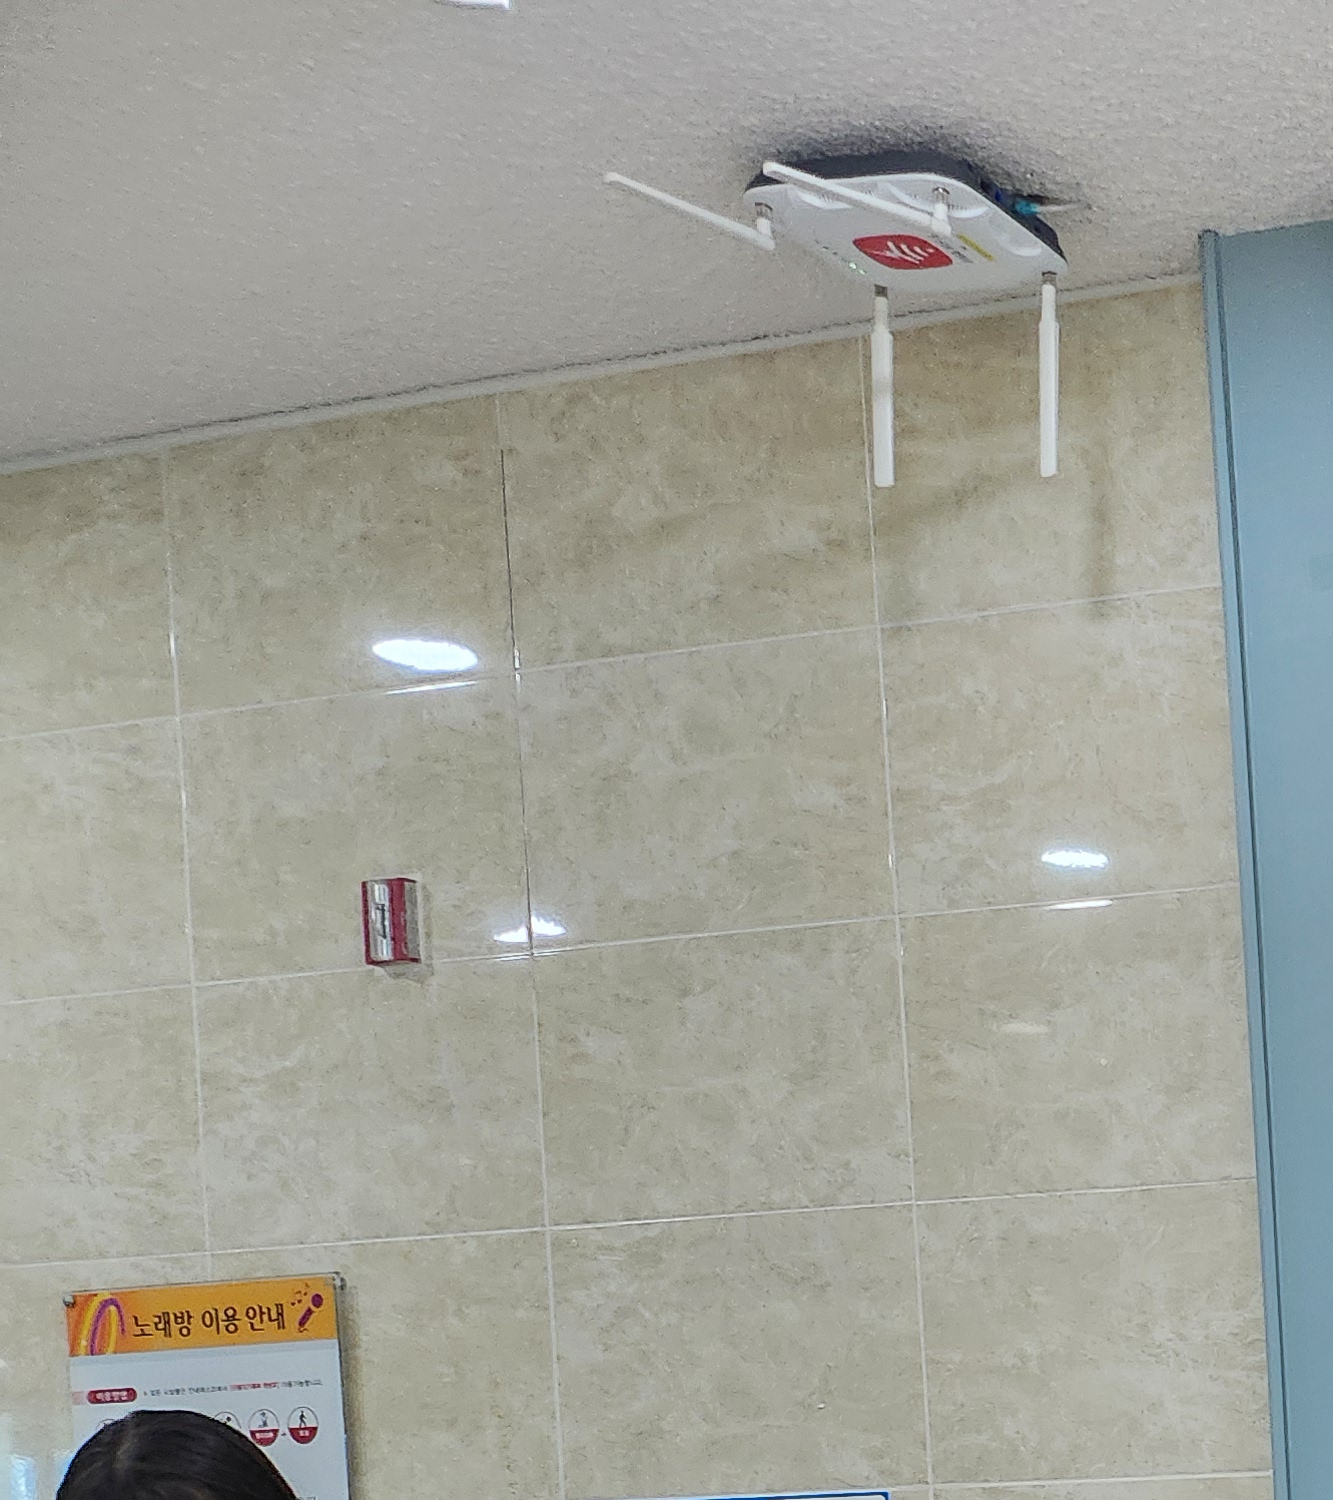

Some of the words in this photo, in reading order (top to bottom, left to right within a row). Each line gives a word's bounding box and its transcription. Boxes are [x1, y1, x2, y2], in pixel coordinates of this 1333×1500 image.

[132, 1310, 194, 1338] 노래방
[201, 1306, 241, 1335] 이용
[245, 1303, 286, 1331] 안내
